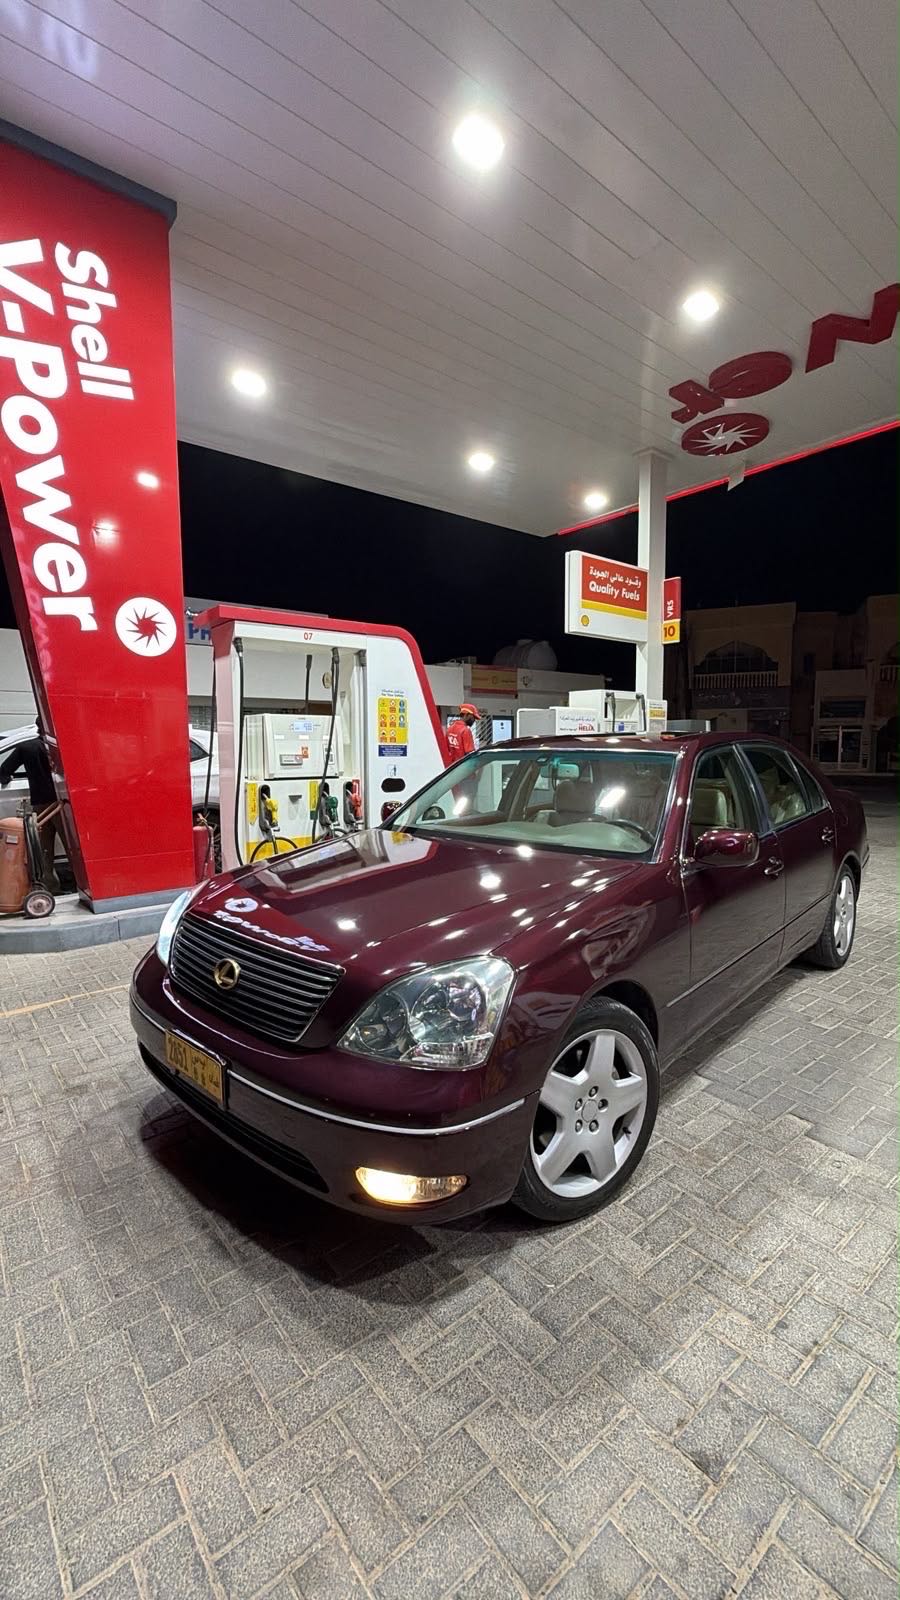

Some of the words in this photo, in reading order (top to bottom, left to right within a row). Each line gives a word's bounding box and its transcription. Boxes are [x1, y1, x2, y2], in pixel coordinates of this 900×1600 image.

[55, 242, 134, 400] Shell
[0, 238, 98, 632] V-Power
[589, 566, 609, 580] الجودة
[610, 573, 624, 583] عالي
[589, 581, 619, 599] Quality
[621, 587, 640, 601] Fuels
[303, 632, 313, 641] 07
[663, 626, 676, 637] 10
